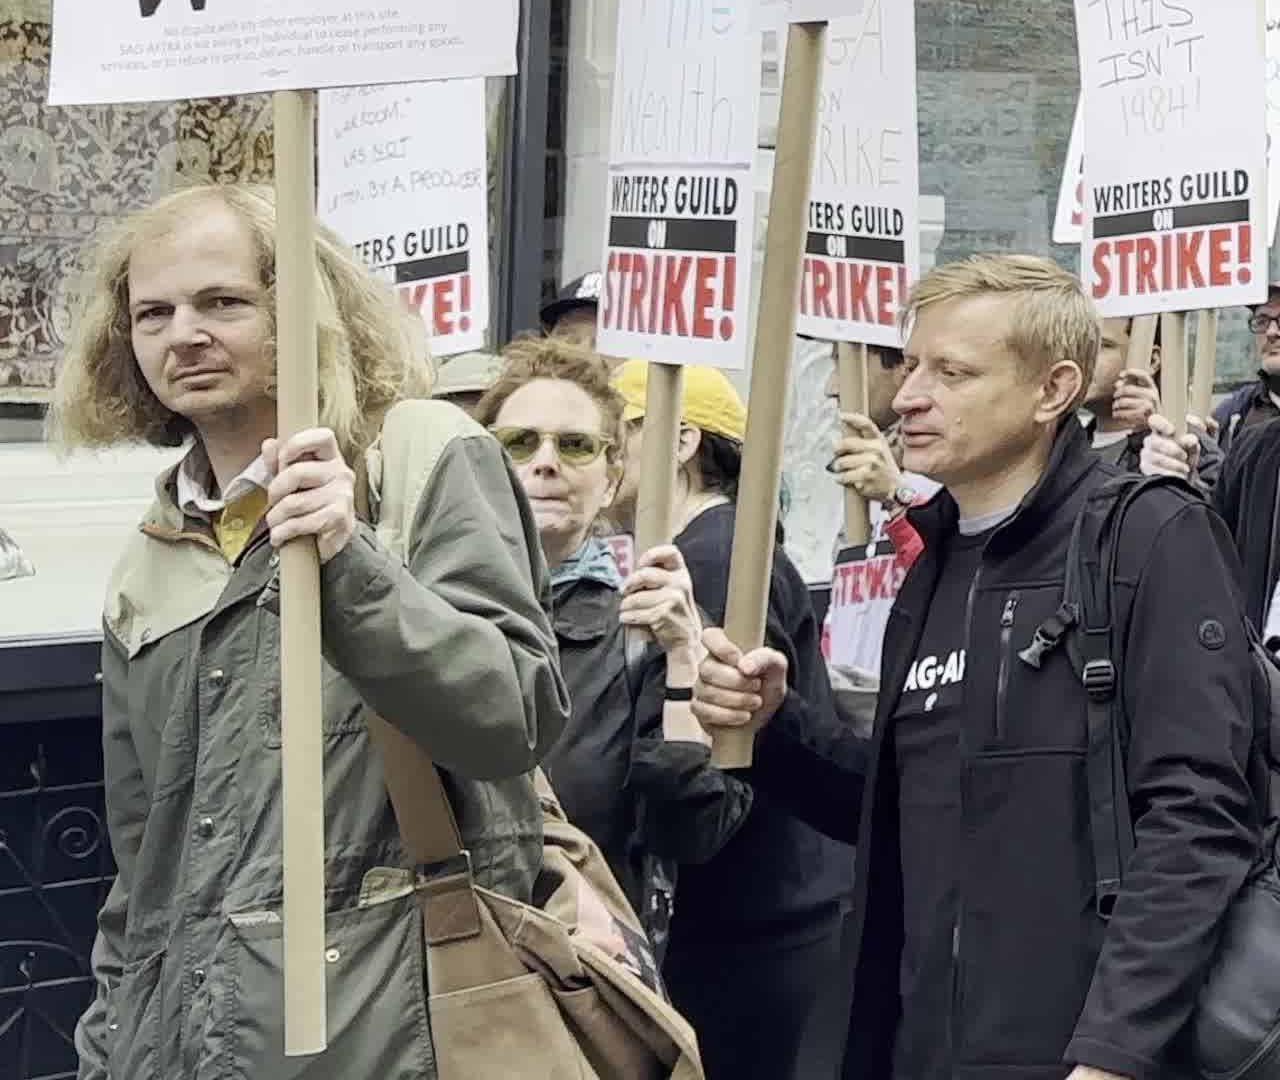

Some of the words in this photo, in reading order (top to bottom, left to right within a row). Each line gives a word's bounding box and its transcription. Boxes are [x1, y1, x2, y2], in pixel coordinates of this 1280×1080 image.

[1098, 35, 1205, 88] ISN'T
[818, 123, 903, 186] RIKE
[612, 174, 669, 216] WRITERS
[674, 174, 738, 217] GUILD
[1093, 177, 1173, 214] WRITERS
[1180, 169, 1249, 201] GUILD
[646, 219, 667, 250] ON
[809, 202, 846, 233] TERS
[851, 206, 904, 237] GUILD
[1153, 207, 1175, 232] ON
[352, 235, 395, 265] TERS
[404, 222, 469, 257] GUILD
[826, 233, 848, 258] ON
[1091, 223, 1253, 300] STRIKE!
[603, 250, 737, 343] STRIKE!
[801, 257, 907, 327] TRIKE!
